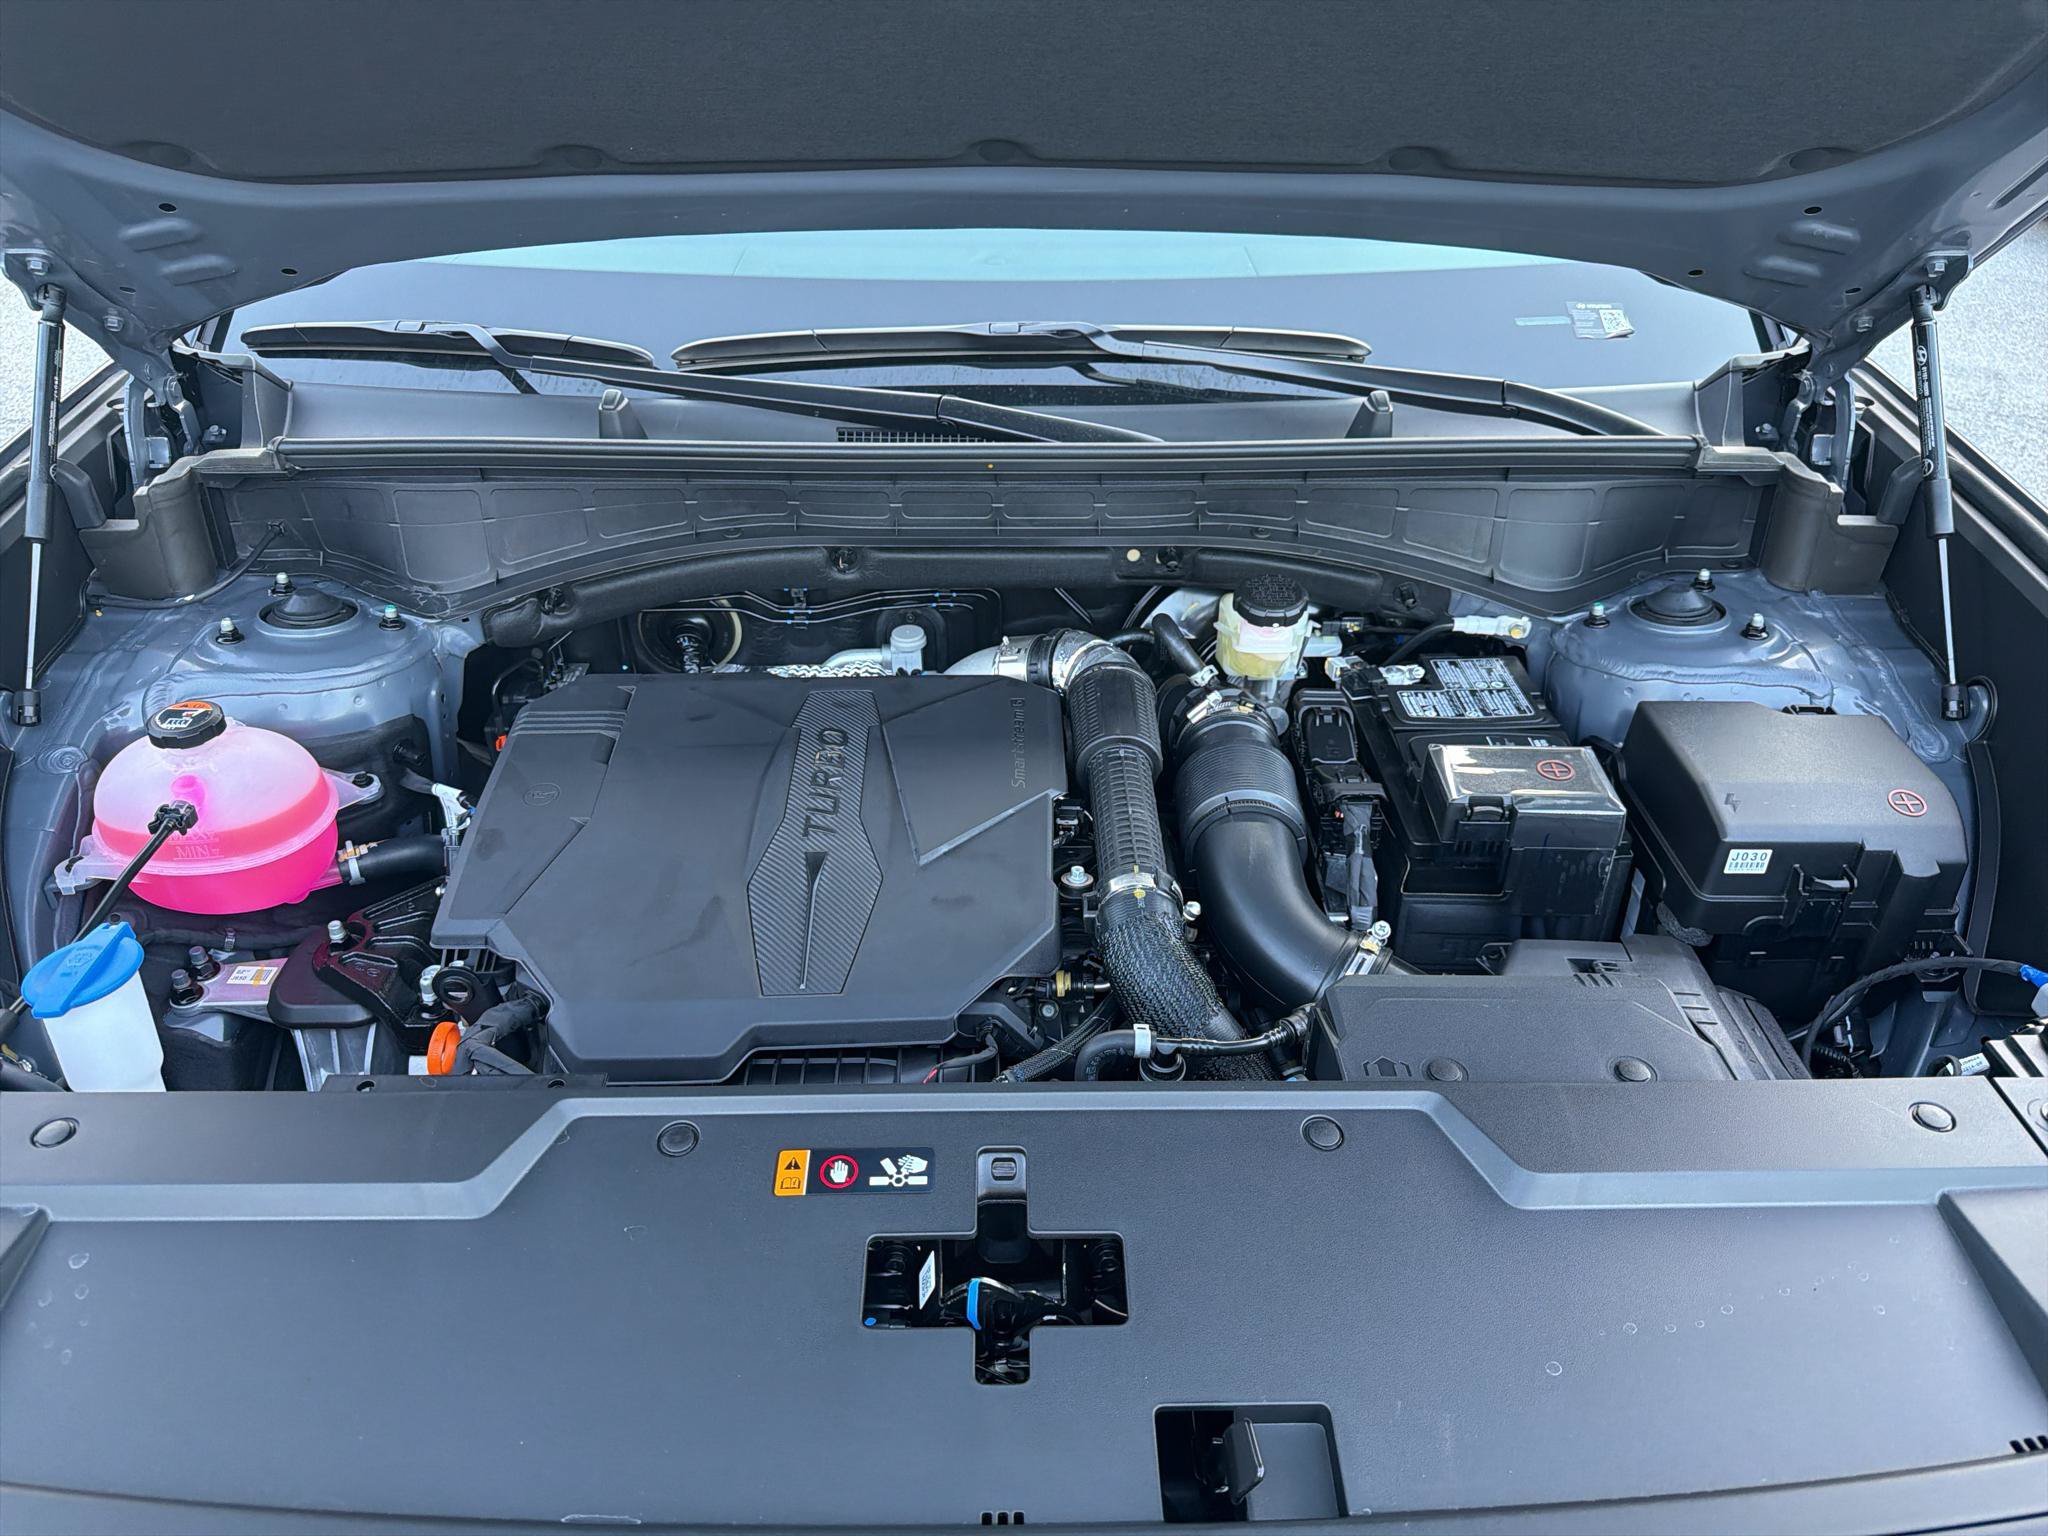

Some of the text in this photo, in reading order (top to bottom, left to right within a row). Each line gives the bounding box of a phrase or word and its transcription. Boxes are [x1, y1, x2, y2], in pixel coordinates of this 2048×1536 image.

[1010, 709, 1026, 789] Smartstream
[802, 726, 849, 839] TURBO
[175, 845, 210, 858] MIN
[1731, 852, 1768, 861] J030
